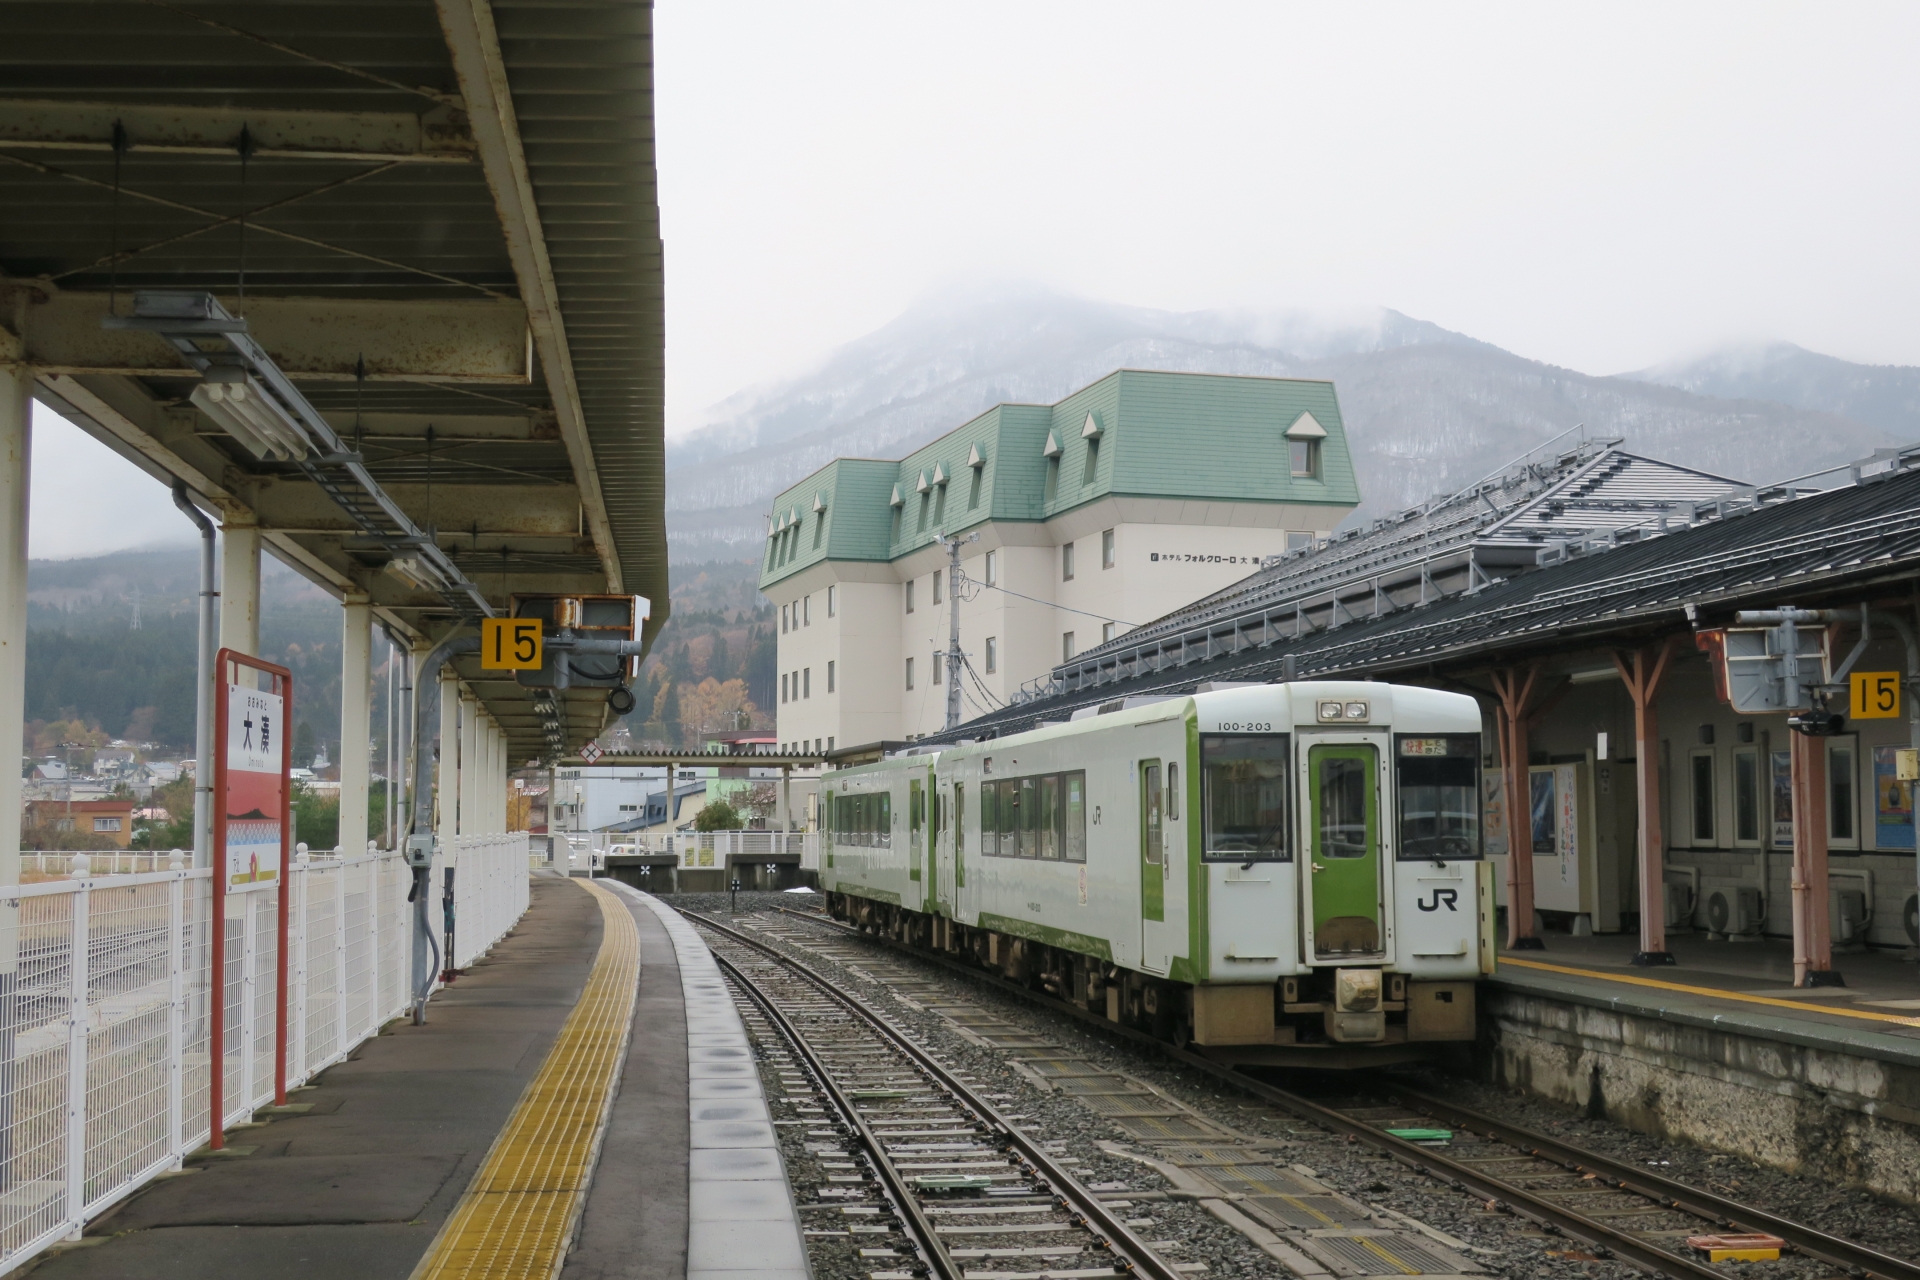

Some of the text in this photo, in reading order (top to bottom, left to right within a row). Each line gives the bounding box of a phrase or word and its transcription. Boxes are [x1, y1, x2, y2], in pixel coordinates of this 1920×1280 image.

[495, 625, 536, 662] 15
[1862, 678, 1895, 712] 15
[243, 711, 270, 755] 大湊
[1218, 722, 1272, 731] 100-203
[1405, 740, 1423, 753] 快速
[1093, 806, 1102, 825] JR
[1417, 888, 1458, 912] JR
